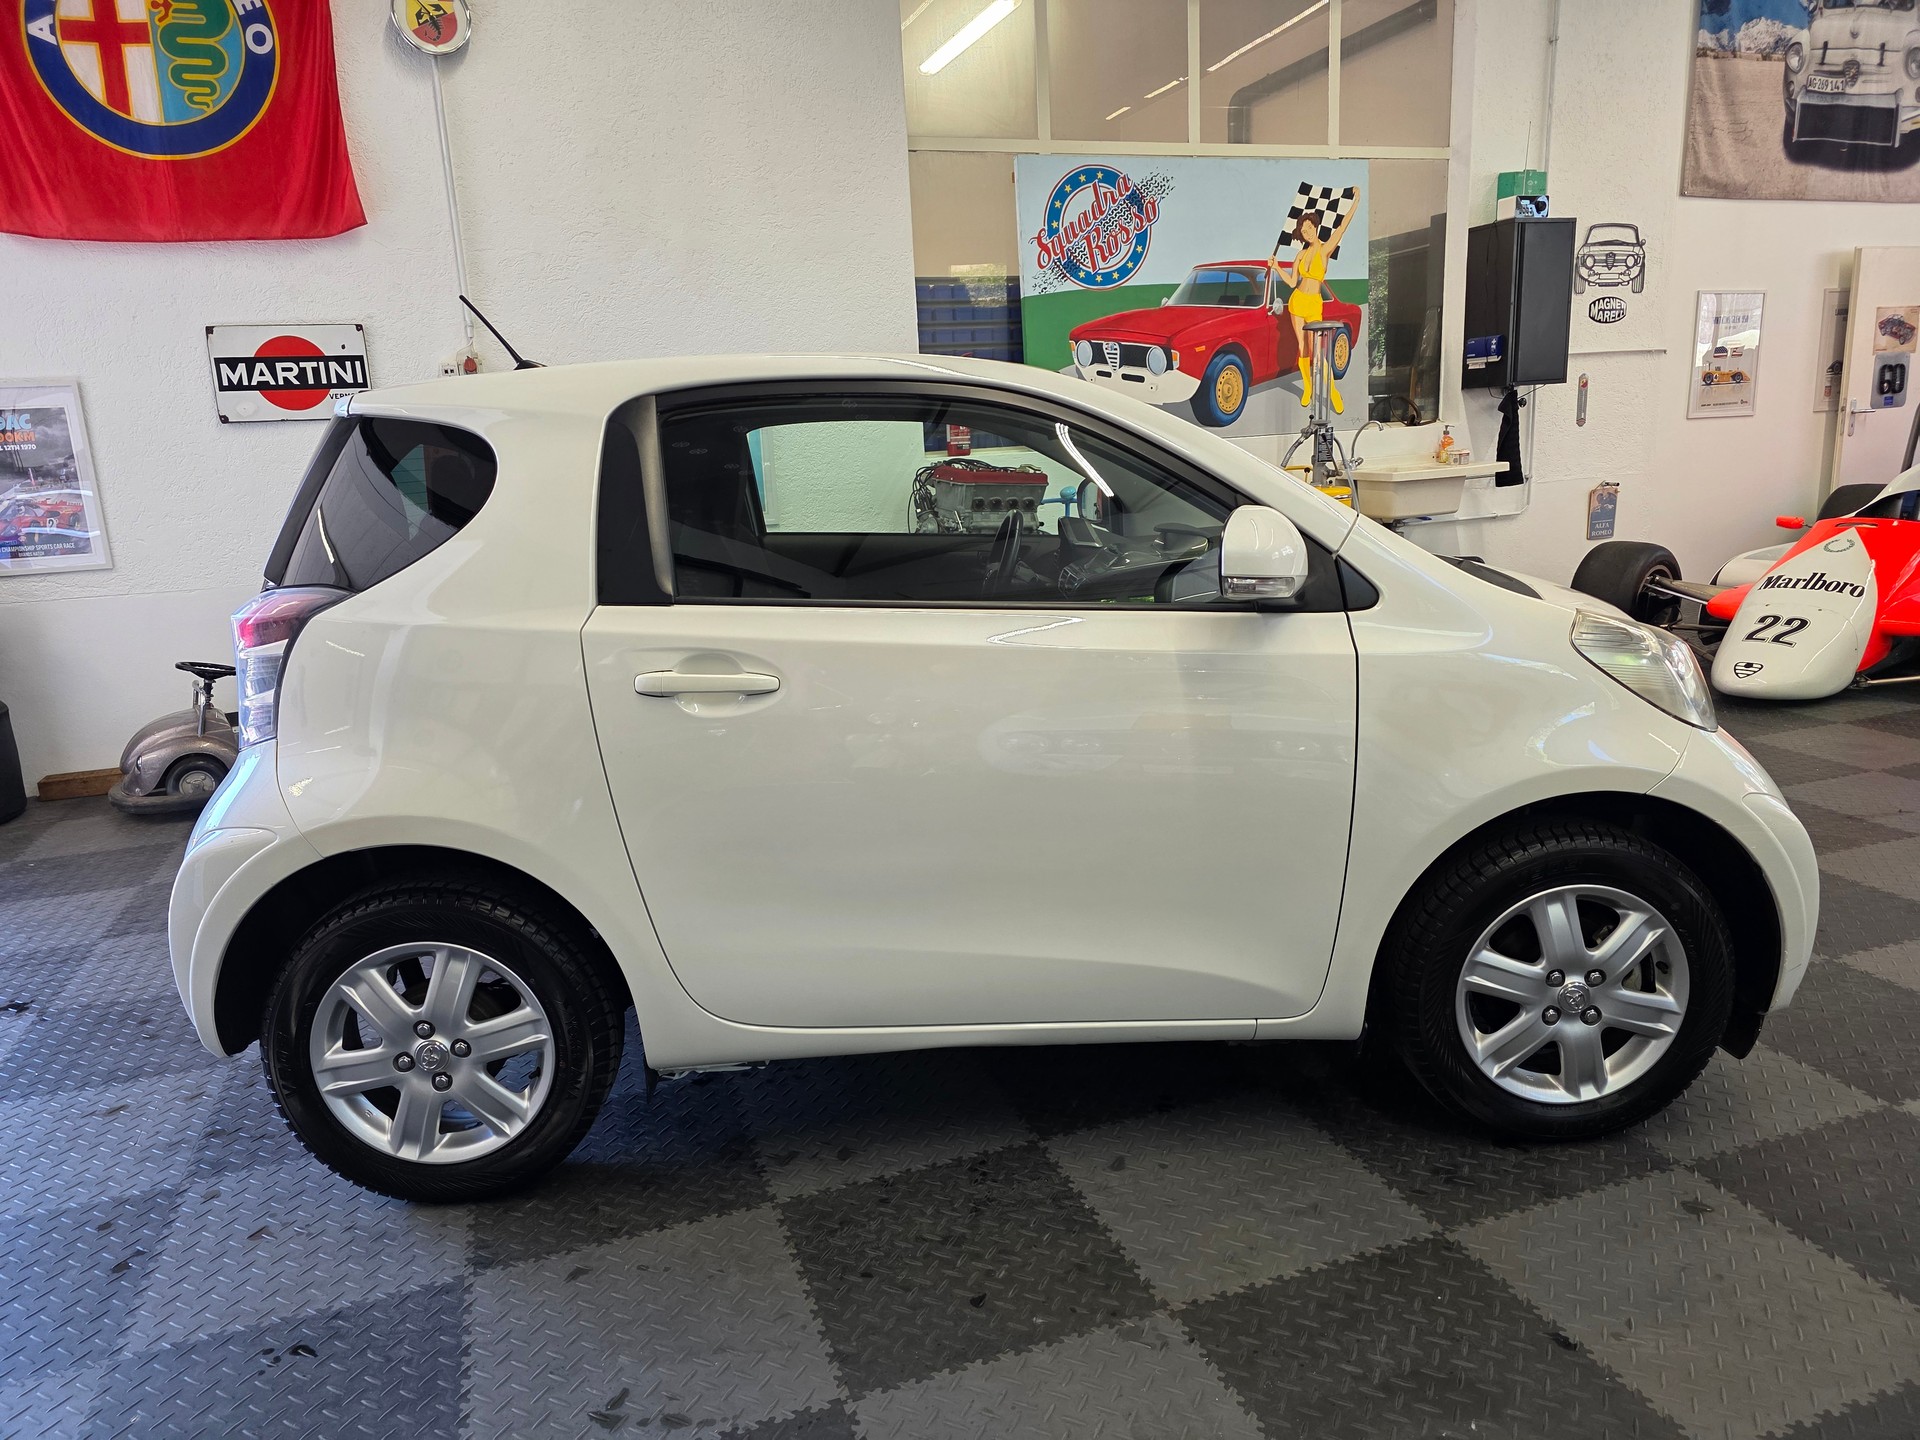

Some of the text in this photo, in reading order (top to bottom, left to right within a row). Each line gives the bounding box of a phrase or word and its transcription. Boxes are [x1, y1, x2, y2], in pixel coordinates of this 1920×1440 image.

[1029, 173, 1132, 269] Squadra
[1084, 196, 1158, 274] Rosso
[219, 361, 364, 386] MARTINI
[1591, 529, 1613, 537] ROMEO
[36, 543, 53, 551] SPORTS
[1758, 572, 1866, 598] Marlboro
[1742, 614, 1811, 648] 22
